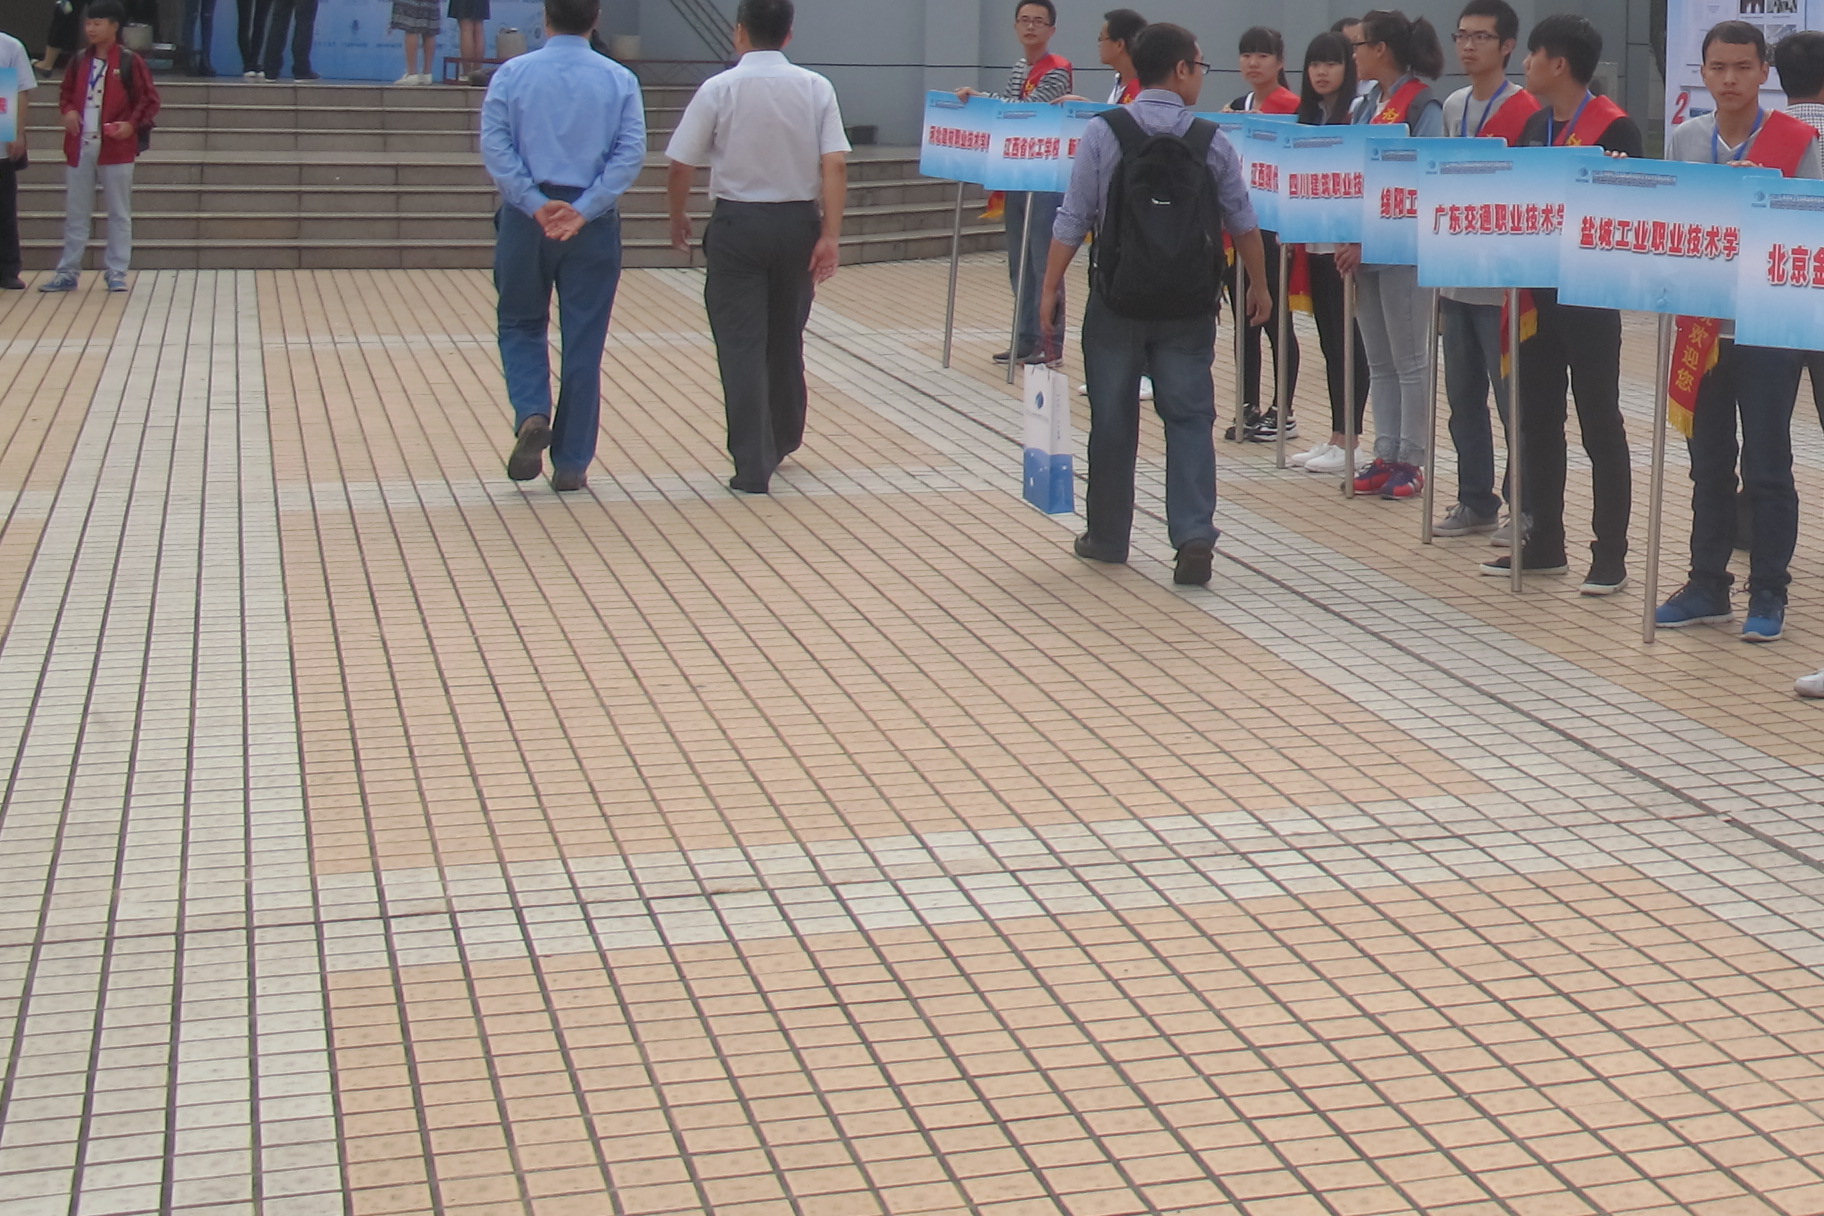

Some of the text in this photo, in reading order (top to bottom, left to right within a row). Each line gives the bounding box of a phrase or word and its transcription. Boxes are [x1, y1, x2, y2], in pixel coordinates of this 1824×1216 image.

[1672, 91, 1690, 125] 2
[1675, 317, 1712, 393] 欢迎您
